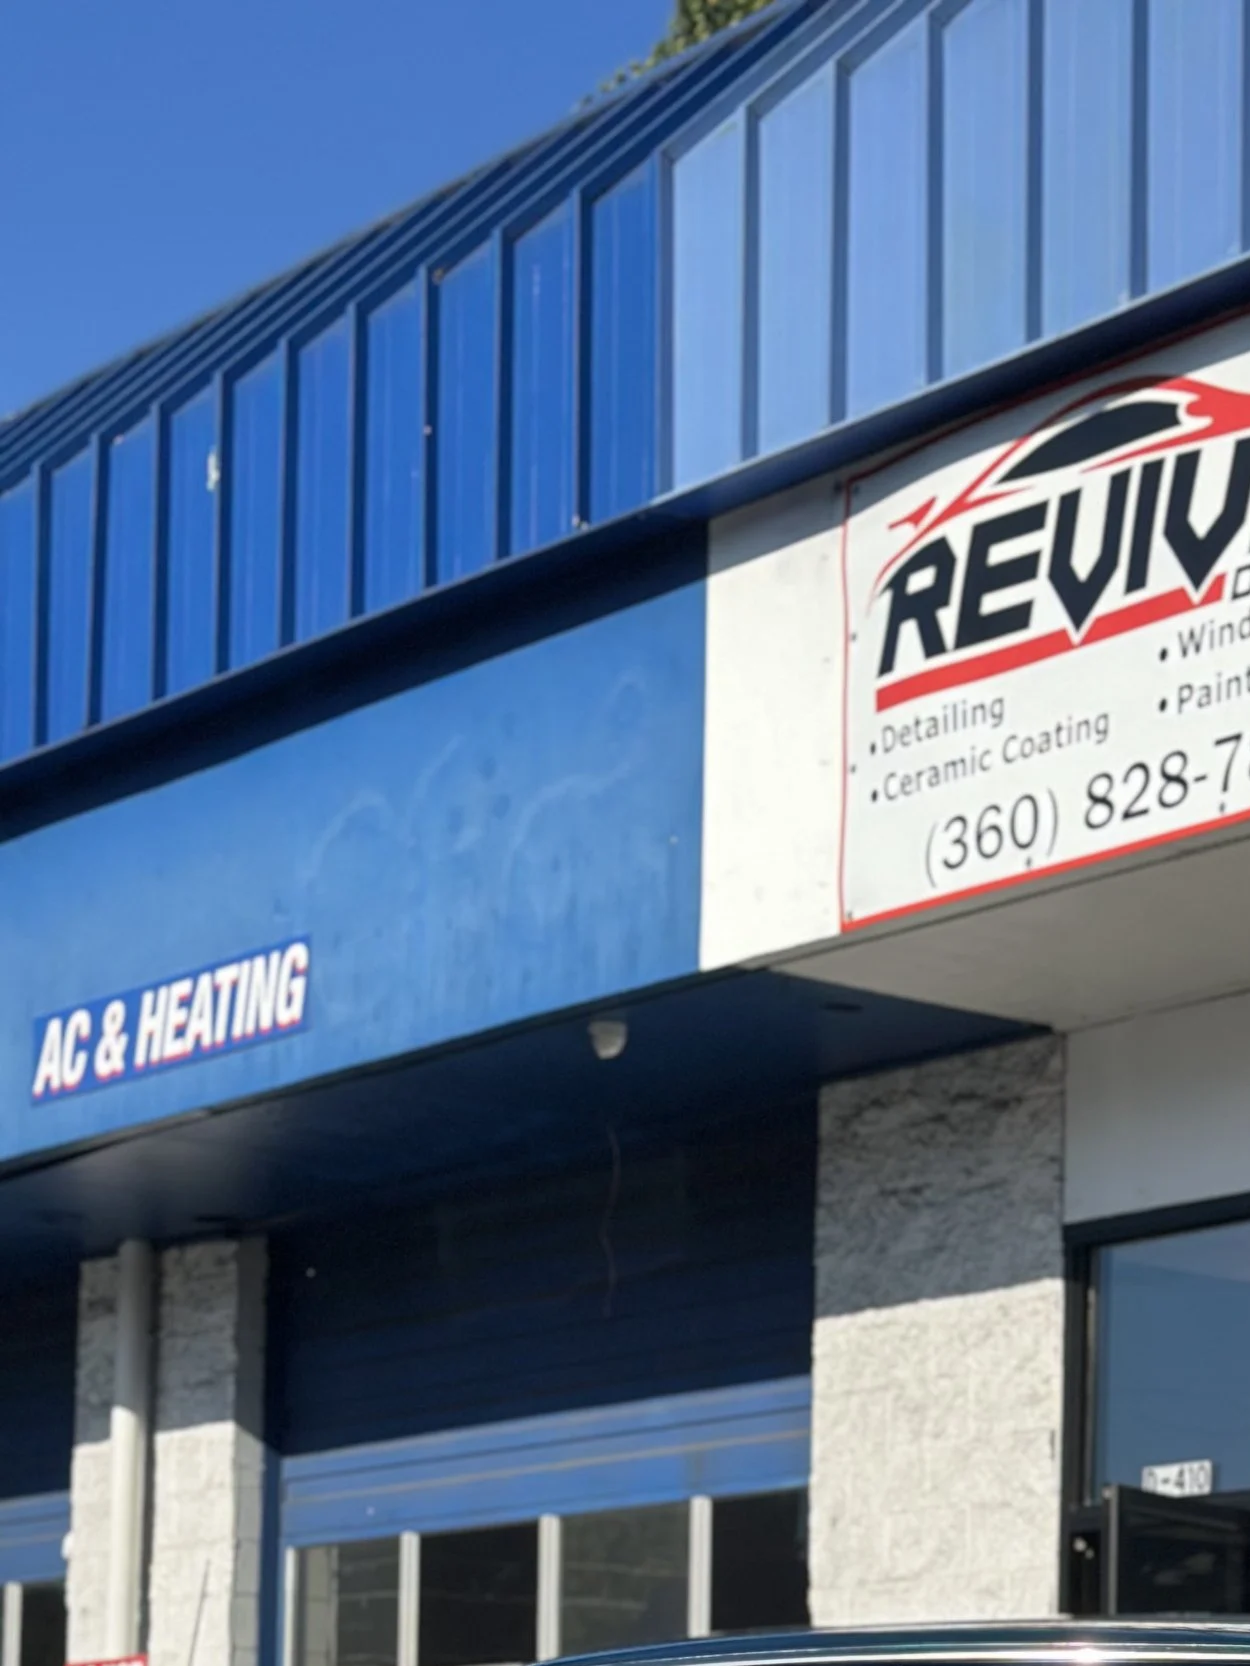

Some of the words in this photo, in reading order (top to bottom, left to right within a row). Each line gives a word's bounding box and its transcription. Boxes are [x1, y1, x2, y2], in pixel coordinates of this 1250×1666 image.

[881, 695, 1006, 755] Detailing
[882, 745, 994, 802] Ceramic
[1001, 711, 1111, 765] Coating
[925, 787, 1060, 889] (360)
[32, 1007, 92, 1098] AC
[94, 999, 129, 1082] &
[133, 941, 310, 1072] HEATING
